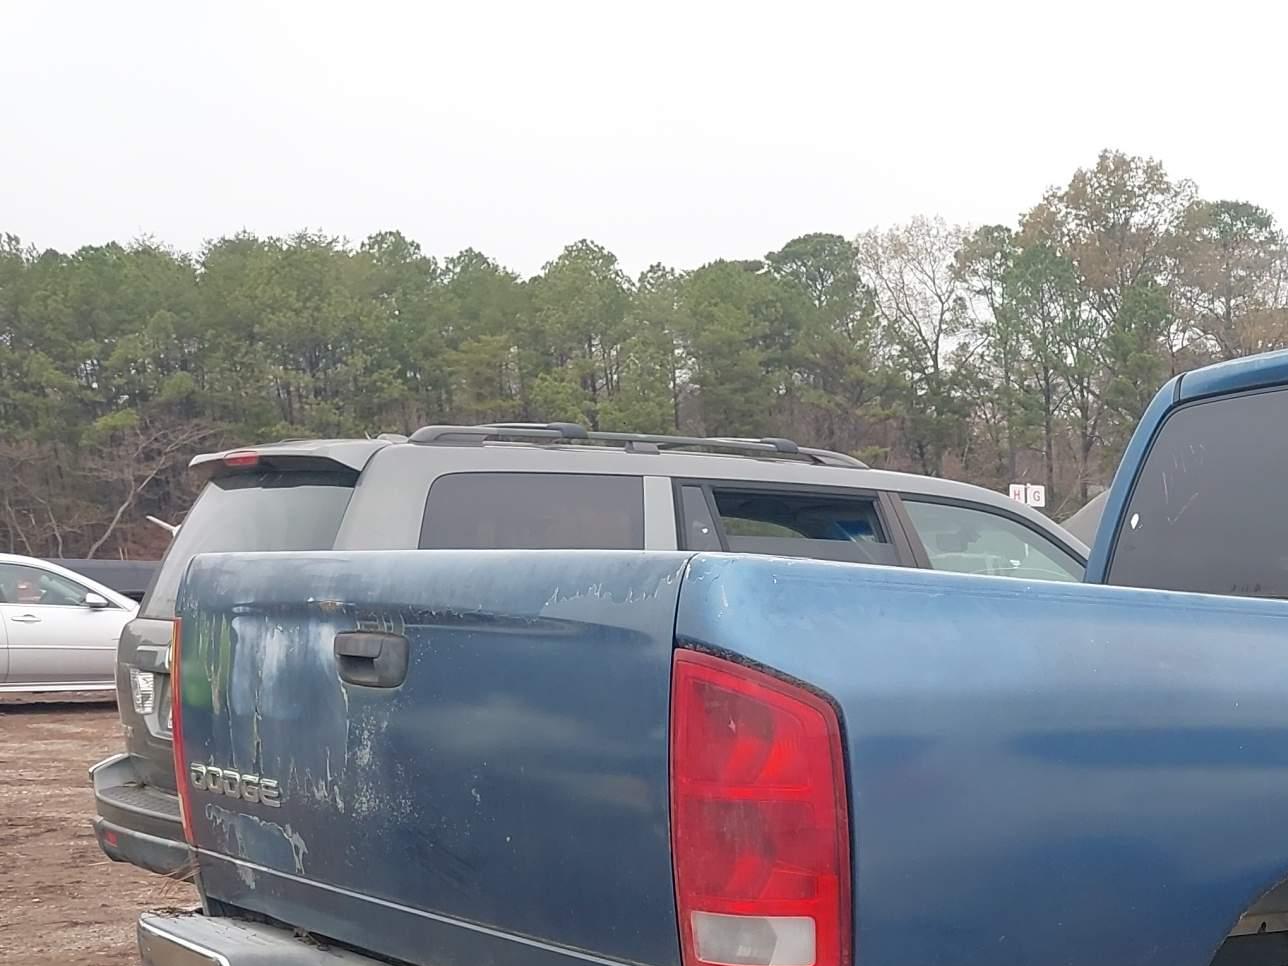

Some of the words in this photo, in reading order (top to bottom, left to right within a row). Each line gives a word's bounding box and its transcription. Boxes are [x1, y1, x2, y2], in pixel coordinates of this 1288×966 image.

[1013, 490, 1021, 501] H
[1033, 490, 1041, 502] G
[190, 762, 281, 808] DODGE
